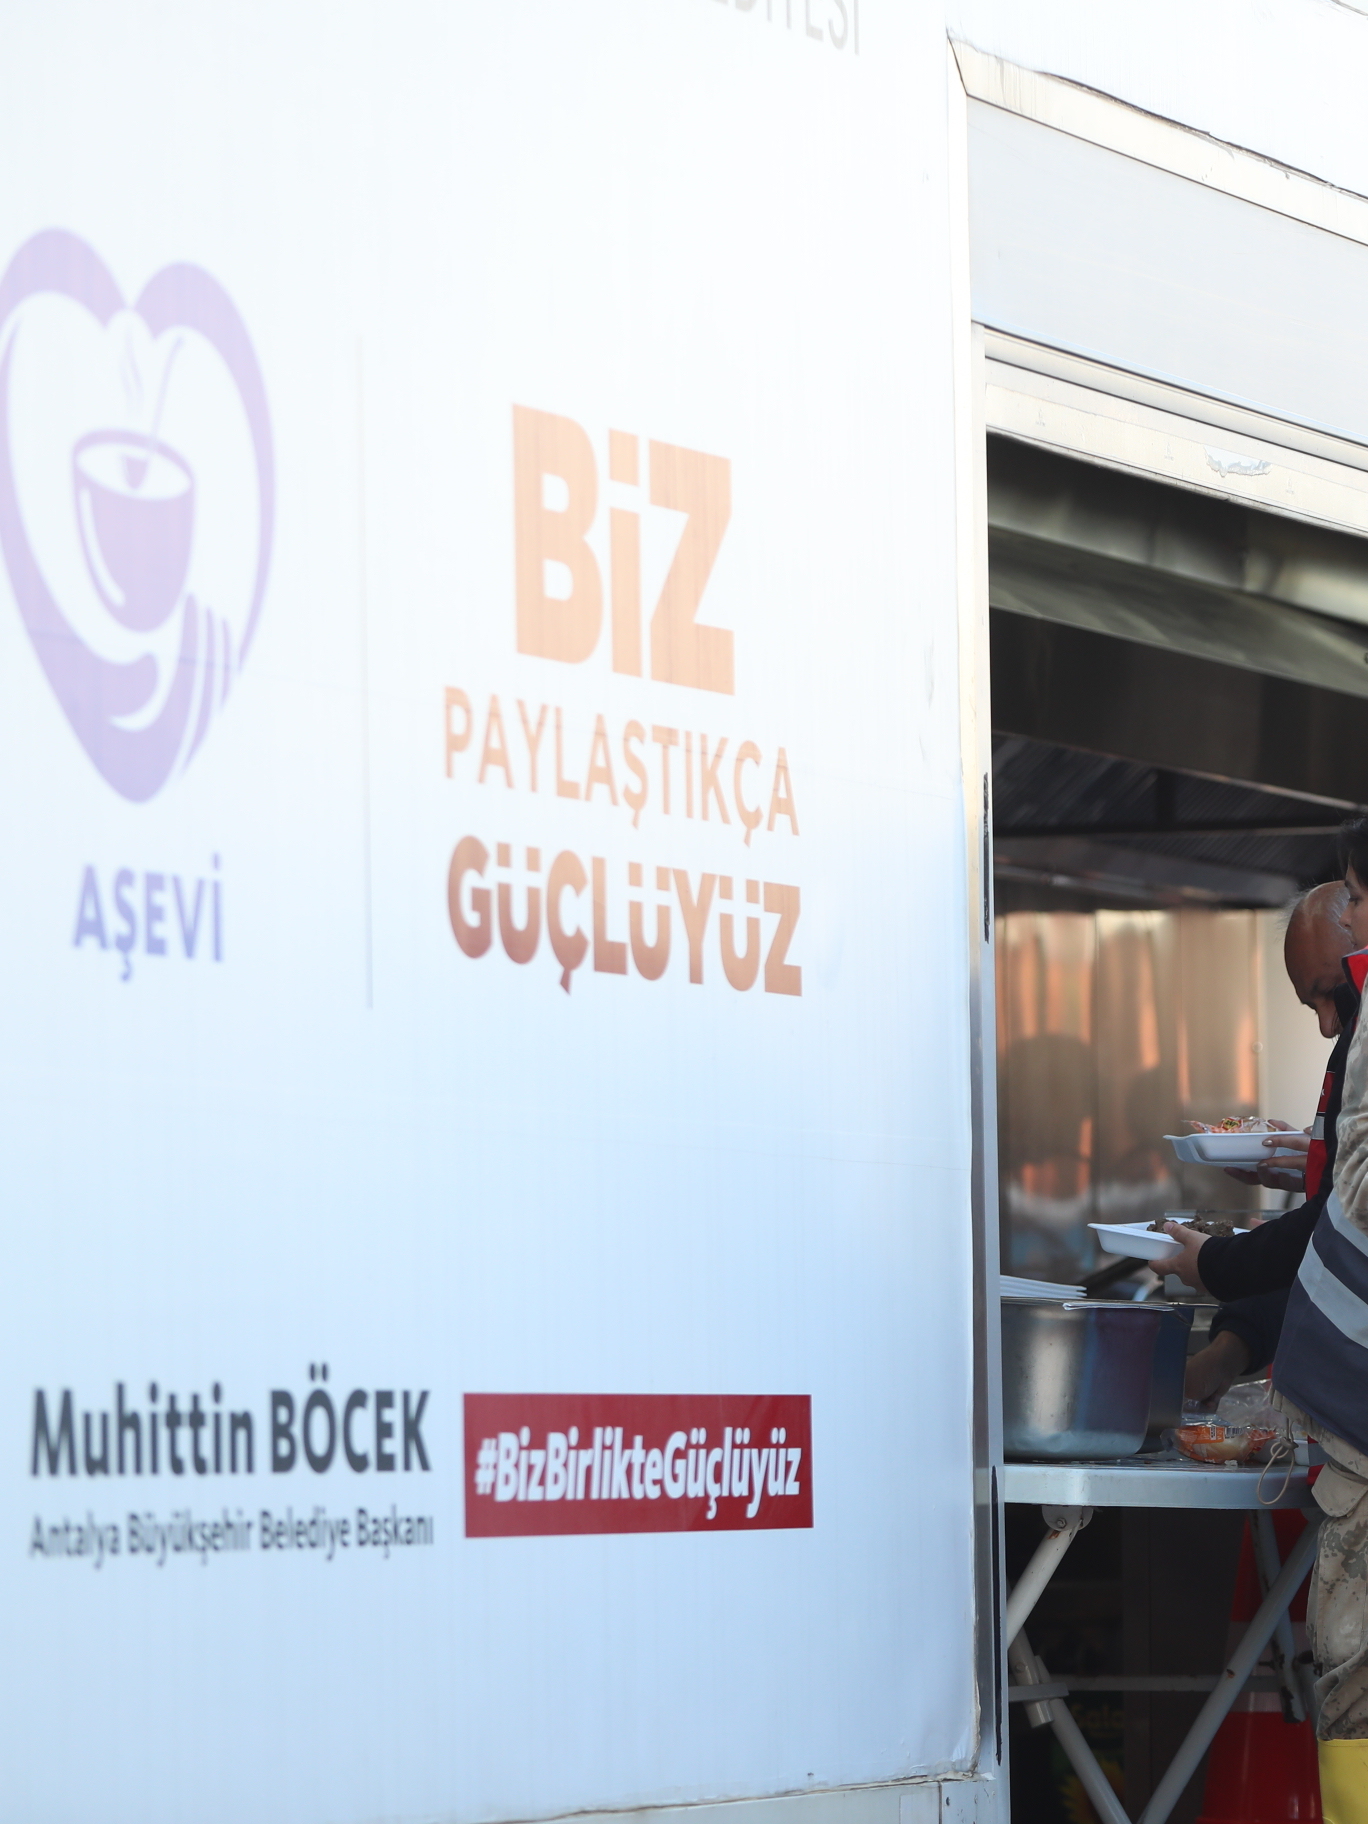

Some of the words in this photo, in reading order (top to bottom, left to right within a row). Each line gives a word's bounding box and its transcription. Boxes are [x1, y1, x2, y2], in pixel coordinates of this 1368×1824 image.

[444, 685, 801, 848] PAYLAŞTIKÇA
[72, 851, 225, 983] AŞEVİ
[447, 834, 803, 997] GÜÇLÜYÜZ
[31, 1381, 255, 1477] Muhittin
[270, 1362, 431, 1474] BÖCEK
[474, 1425, 802, 1520] #BizBirlikteGüçlüyüz
[30, 1509, 121, 1571] Antalya
[127, 1507, 254, 1567] Büyükşehir
[259, 1505, 351, 1562] Belediye
[356, 1502, 434, 1560] Başkanı
